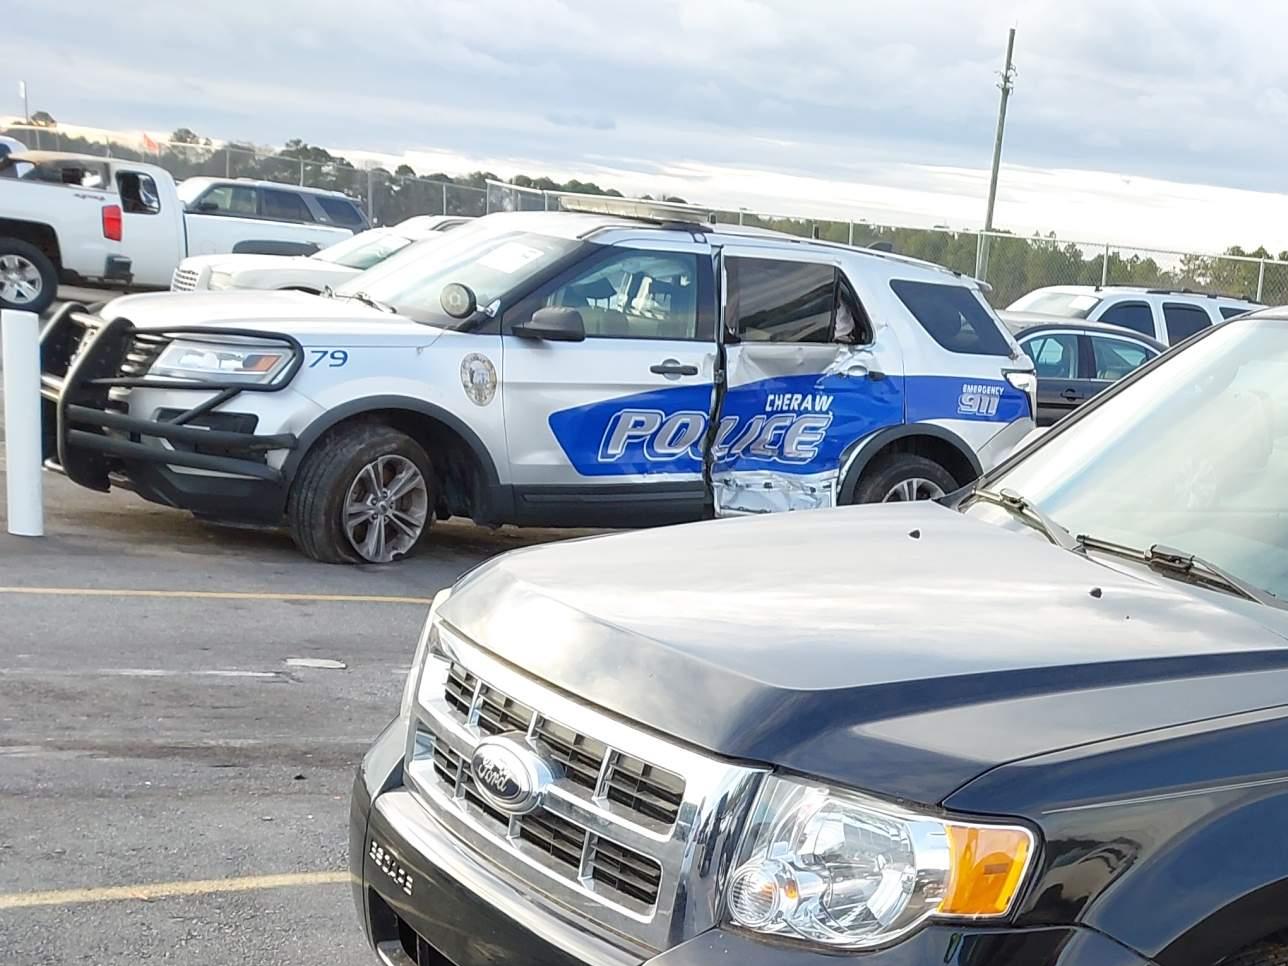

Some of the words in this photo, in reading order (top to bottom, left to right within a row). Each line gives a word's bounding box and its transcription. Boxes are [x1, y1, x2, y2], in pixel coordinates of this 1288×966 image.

[309, 350, 348, 368] 79
[962, 384, 1004, 396] EMERGENCY
[765, 394, 834, 412] CHERAW
[957, 394, 1000, 416] 911
[598, 409, 833, 464] POLICE
